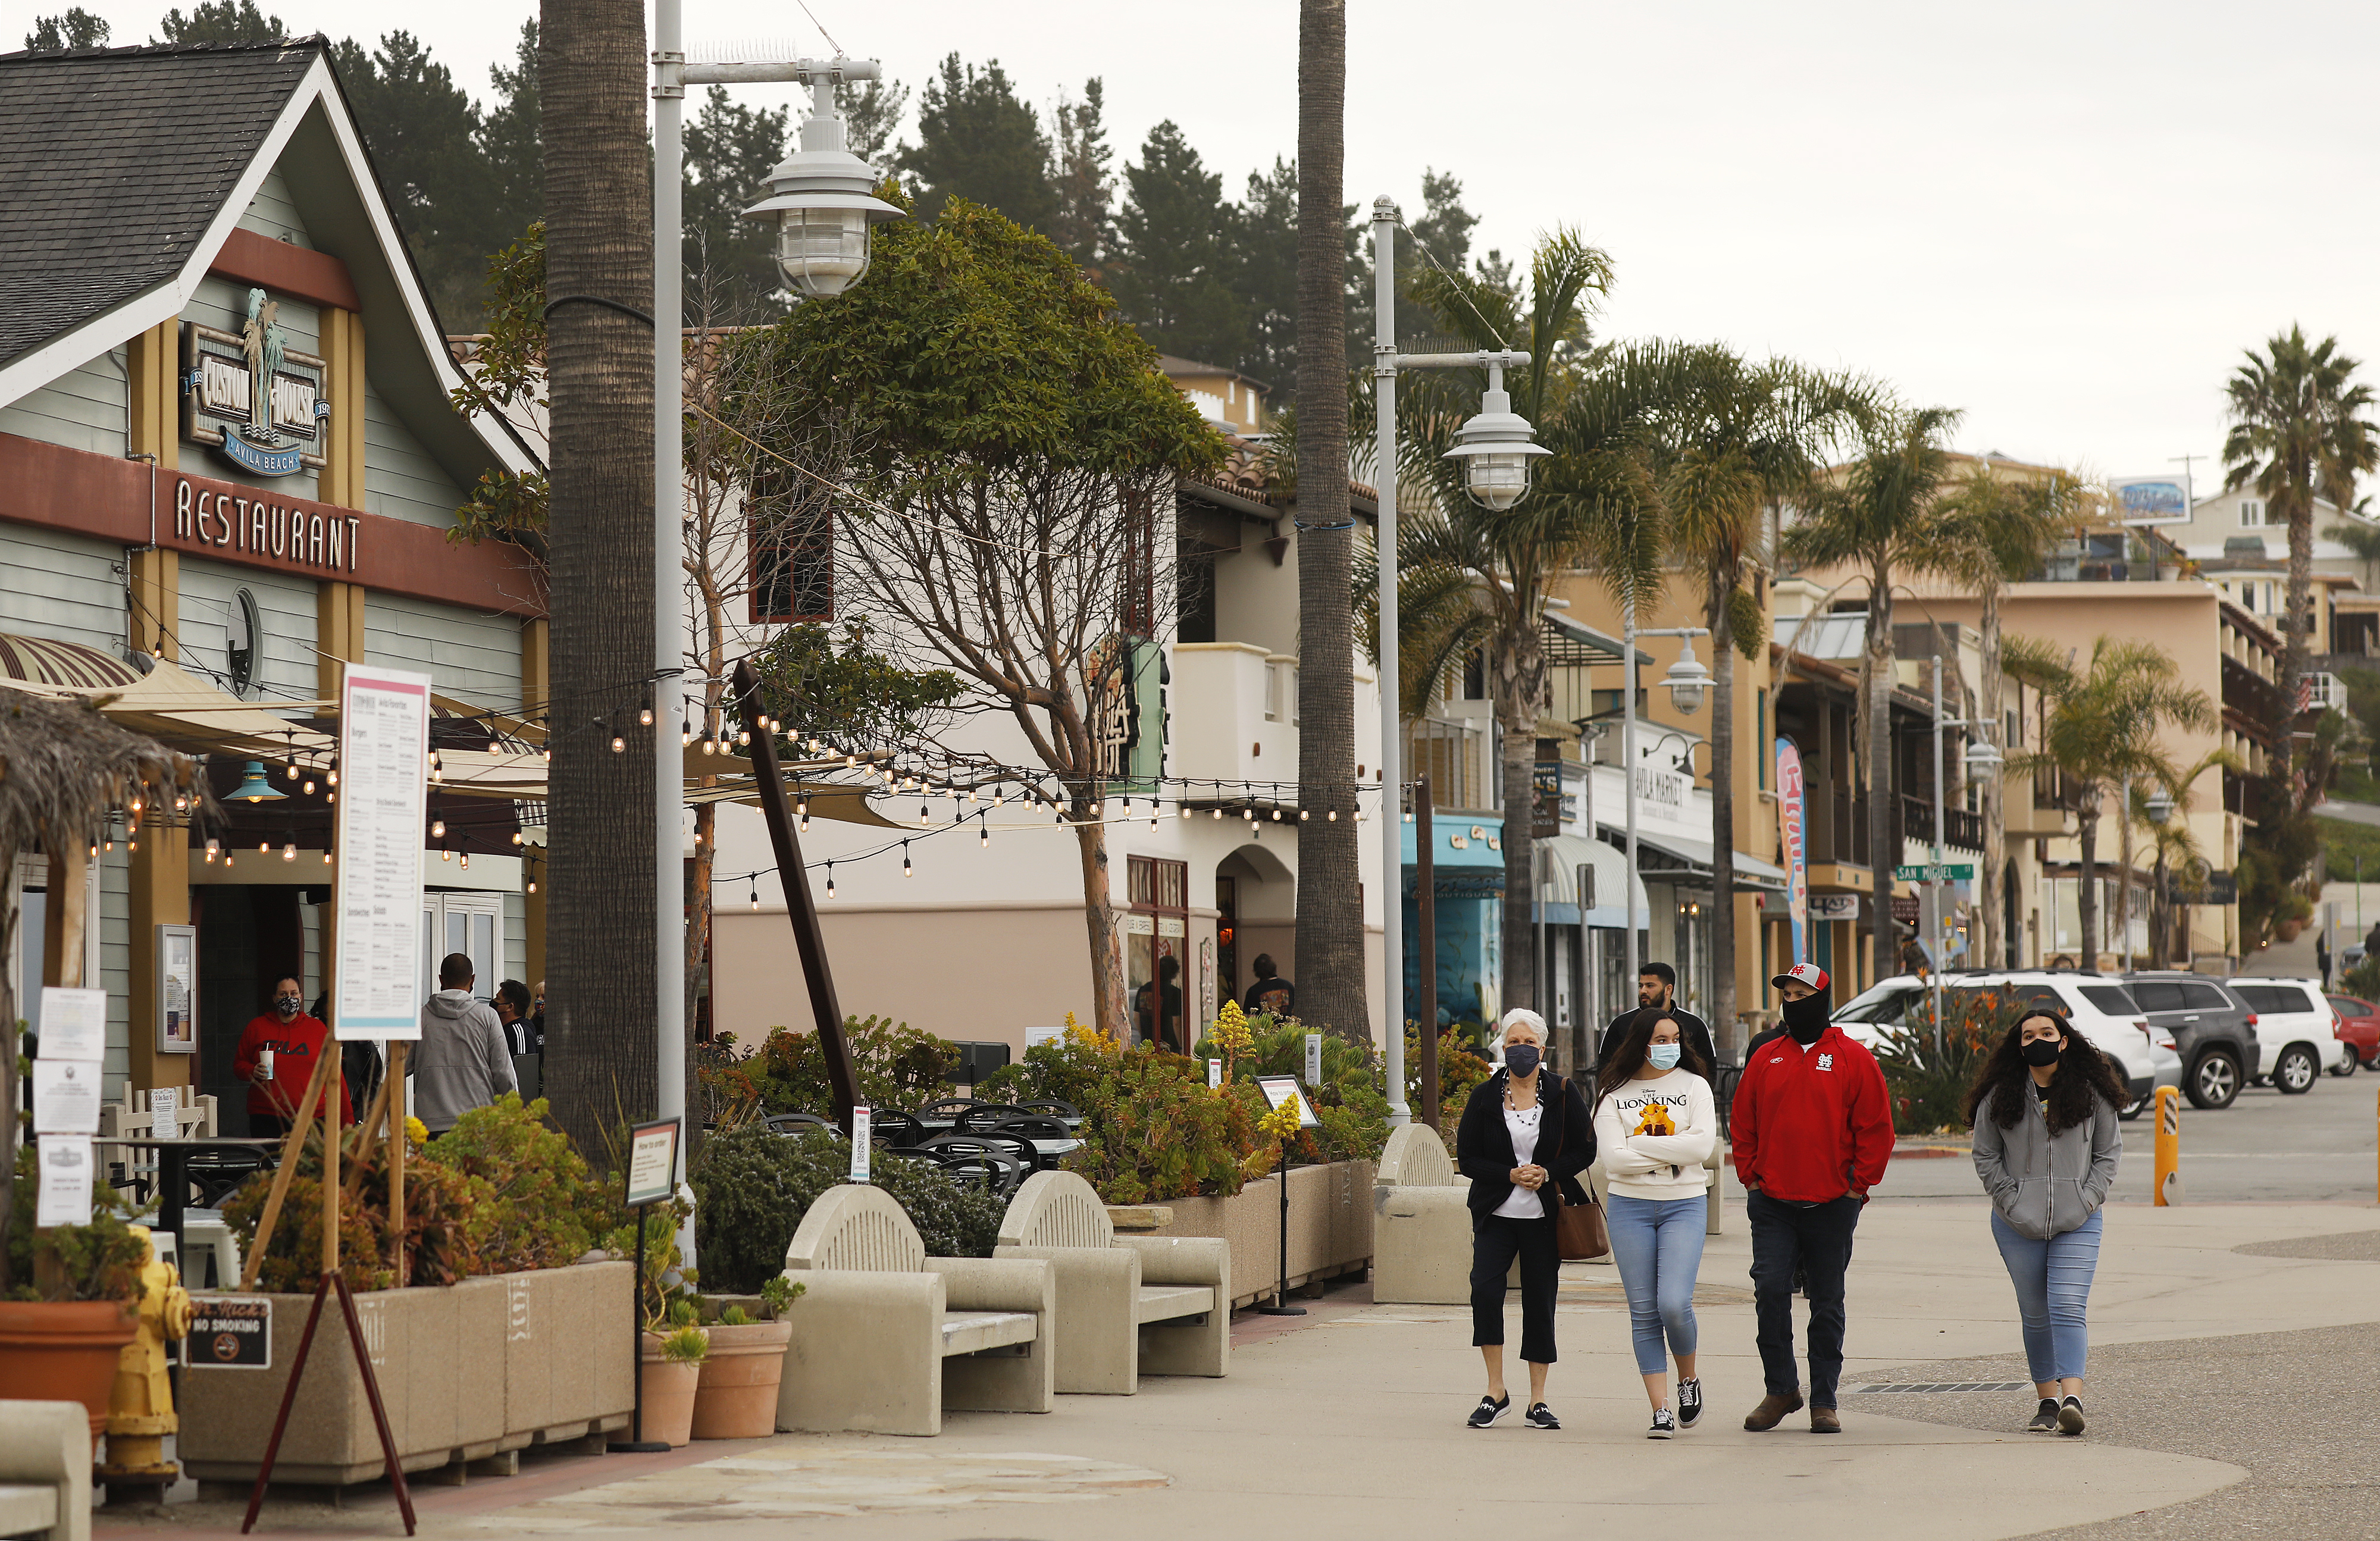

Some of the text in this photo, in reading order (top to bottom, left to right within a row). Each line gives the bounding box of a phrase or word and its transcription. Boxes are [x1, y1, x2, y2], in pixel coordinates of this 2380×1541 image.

[193, 370, 203, 384] ES
[201, 356, 315, 427] CUSTOM HOUSE
[234, 443, 294, 469] AVILA BEACH
[176, 478, 360, 572] RESTAURANT
[1534, 775, 1558, 793] L'S
[1636, 766, 1682, 807] AVILA MARKET
[1897, 866, 1916, 879] SAN
[1922, 866, 1953, 879] MIGUEL
[262, 1039, 309, 1056] FILA
[1615, 1095, 1687, 1110] LION KING
[638, 1141, 648, 1151] How
[649, 1141, 654, 1149] to
[193, 1318, 260, 1333] NO SMOKING
[1478, 1402, 1496, 1412] MMY
